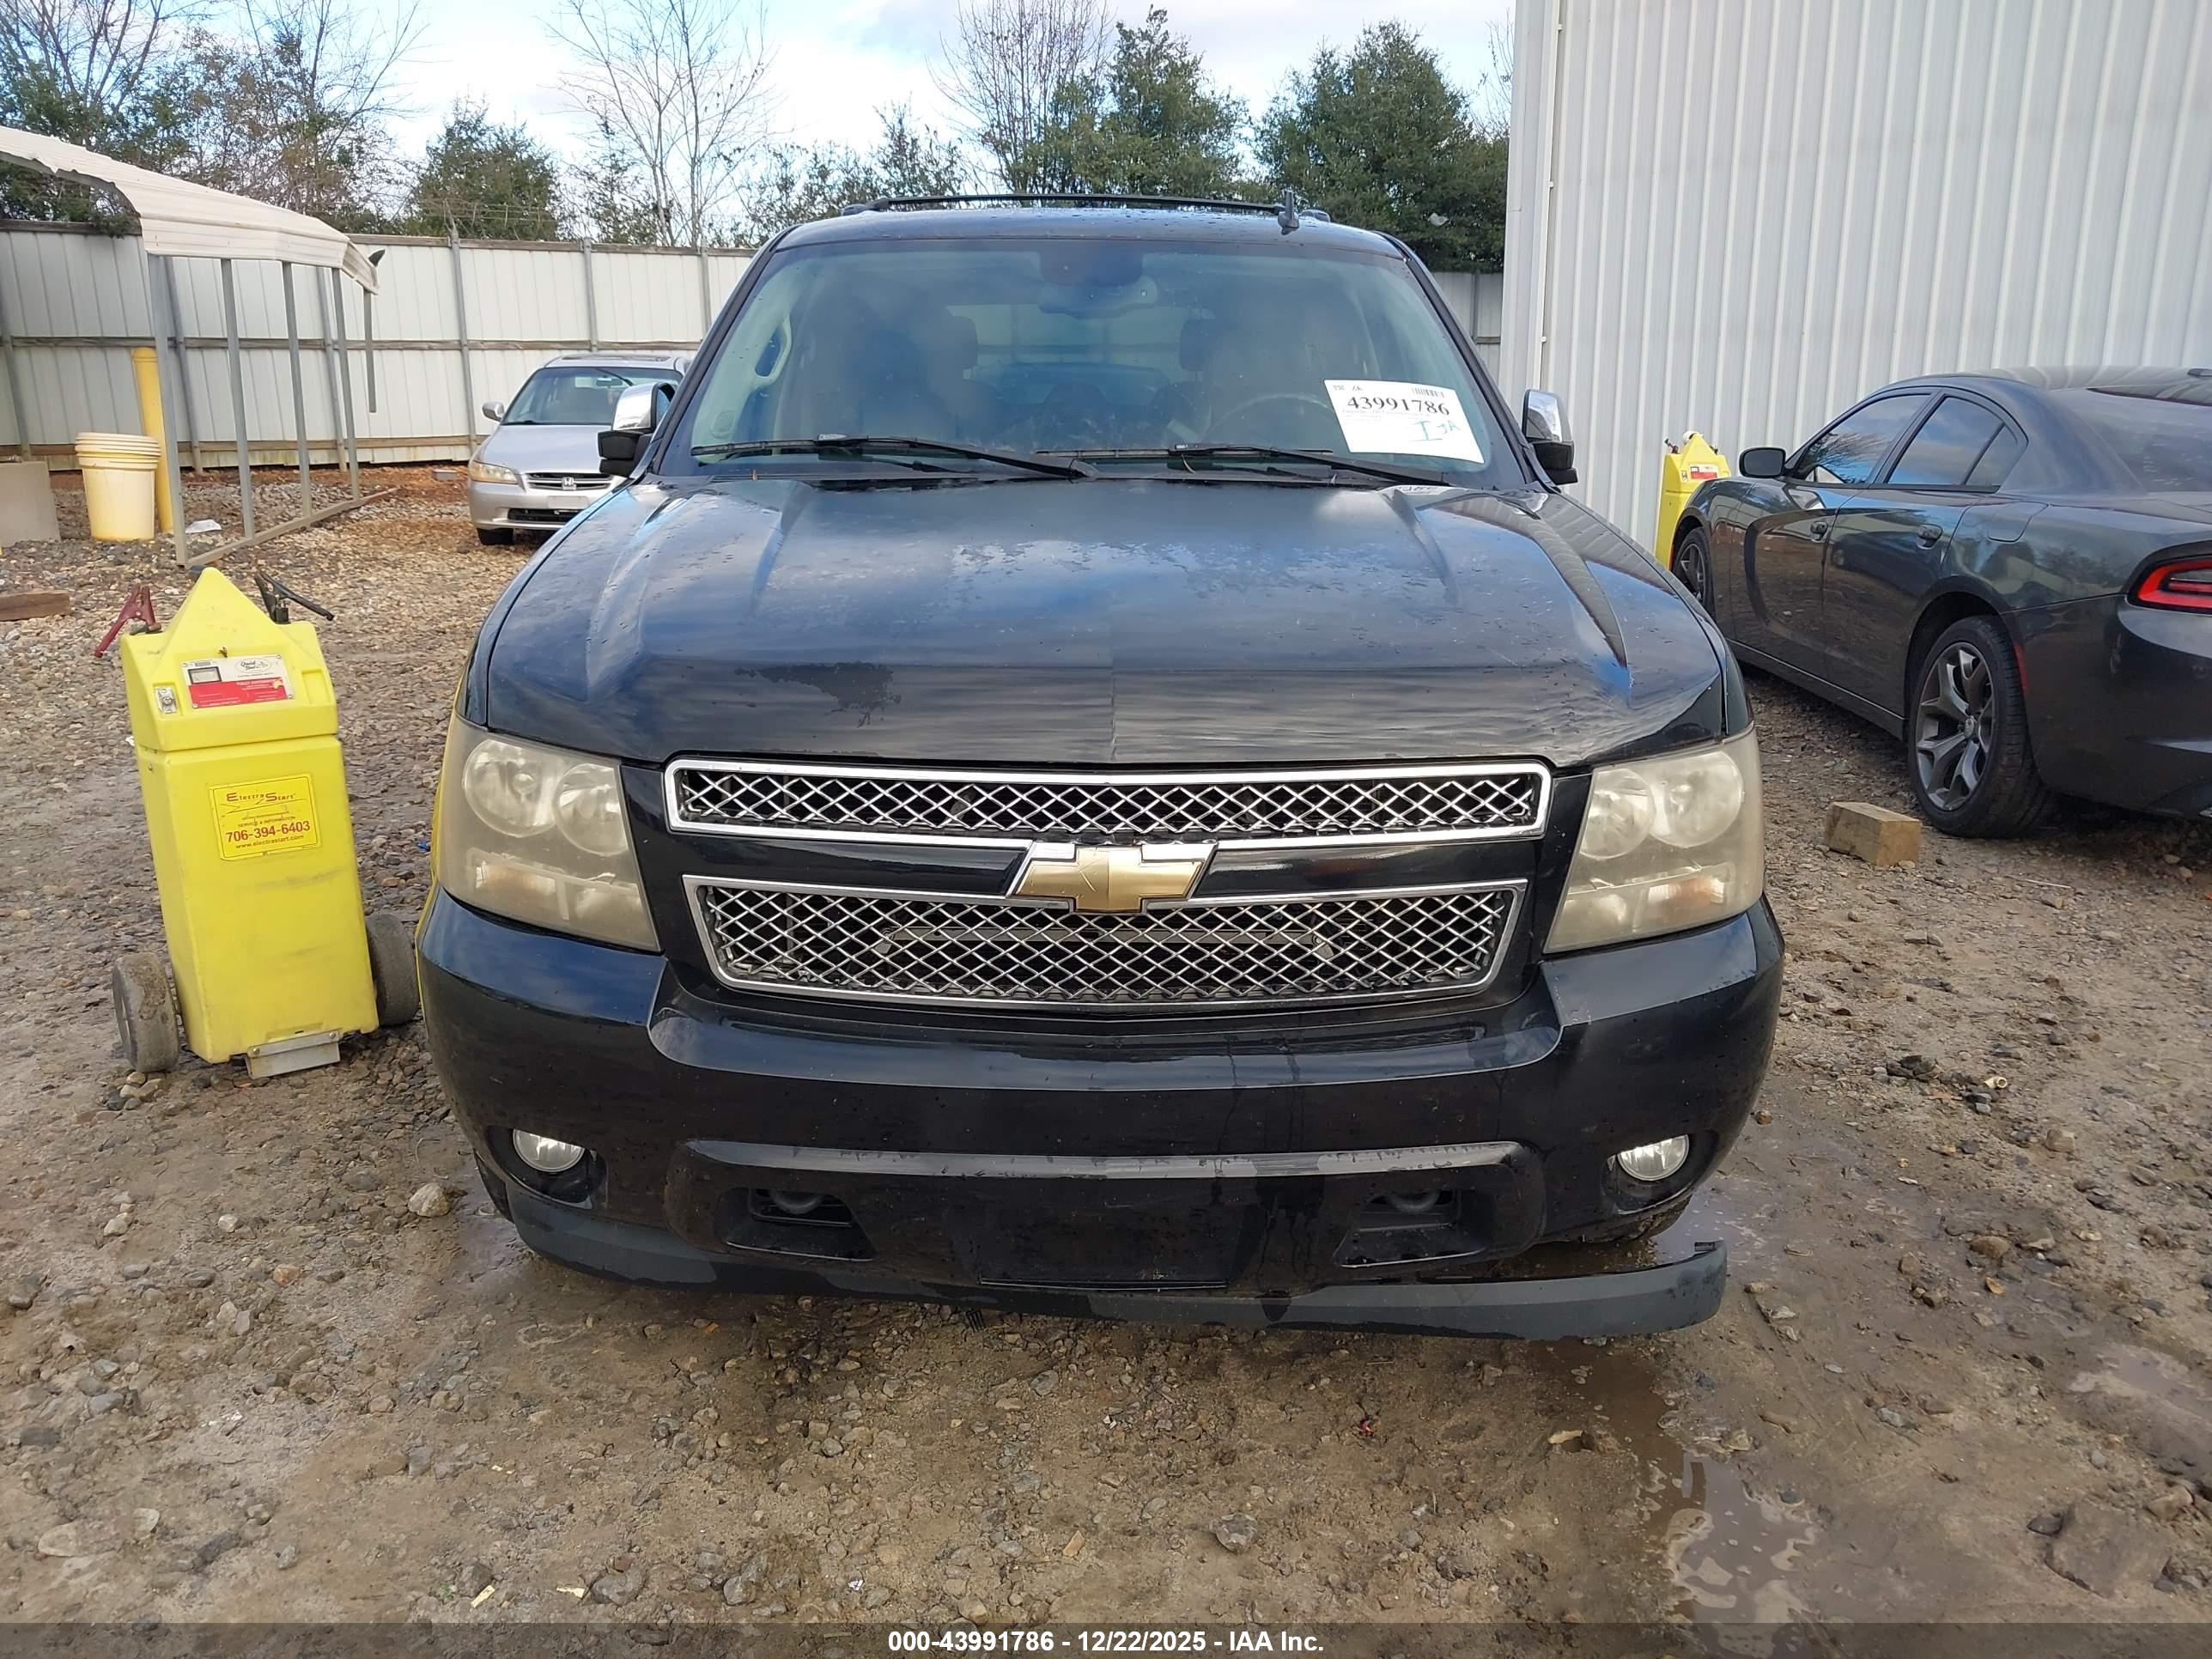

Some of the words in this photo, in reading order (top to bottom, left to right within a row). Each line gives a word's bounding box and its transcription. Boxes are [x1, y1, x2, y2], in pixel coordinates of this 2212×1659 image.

[1347, 396, 1449, 416] 43991786
[226, 820, 310, 843] 706-394-6403
[235, 835, 304, 849] www.electrastart.com
